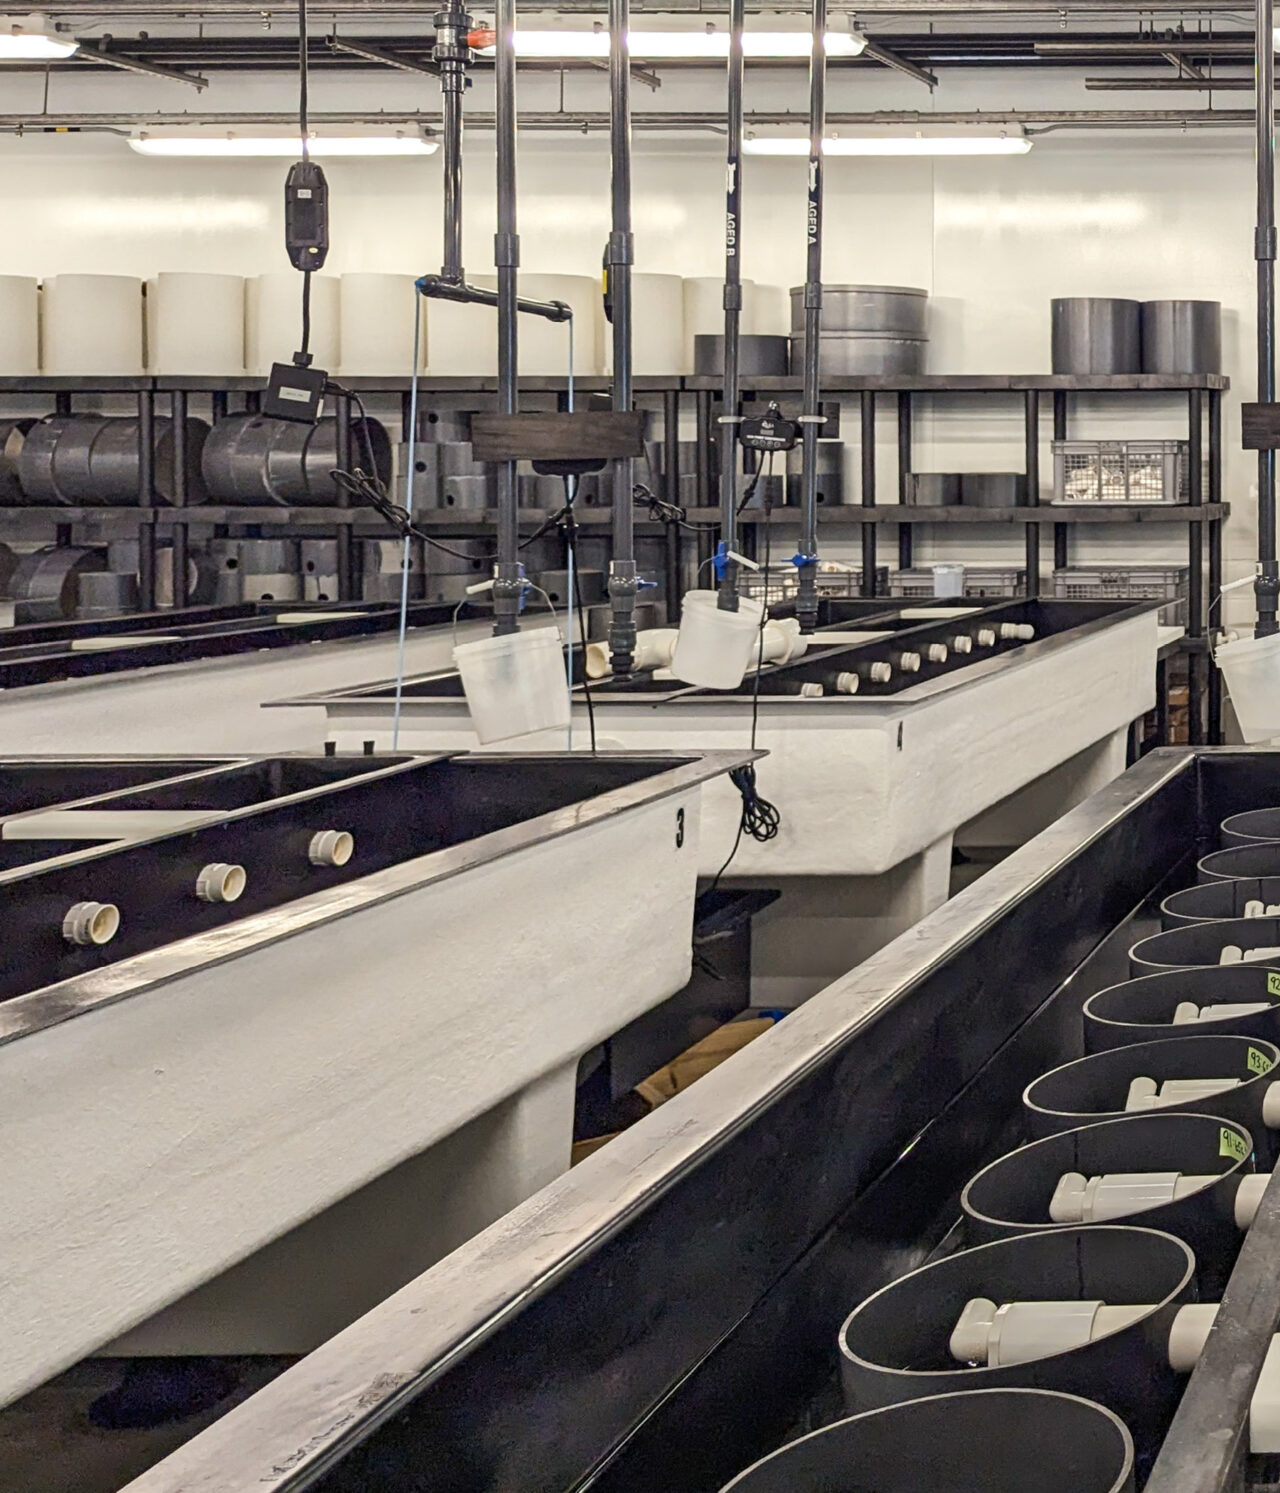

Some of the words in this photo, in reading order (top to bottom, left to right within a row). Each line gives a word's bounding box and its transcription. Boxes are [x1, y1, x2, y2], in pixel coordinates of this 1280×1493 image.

[727, 212, 736, 245] AGED
[808, 201, 817, 233] AGED
[727, 248, 736, 256] B
[808, 236, 817, 244] A
[676, 808, 685, 848] 3
